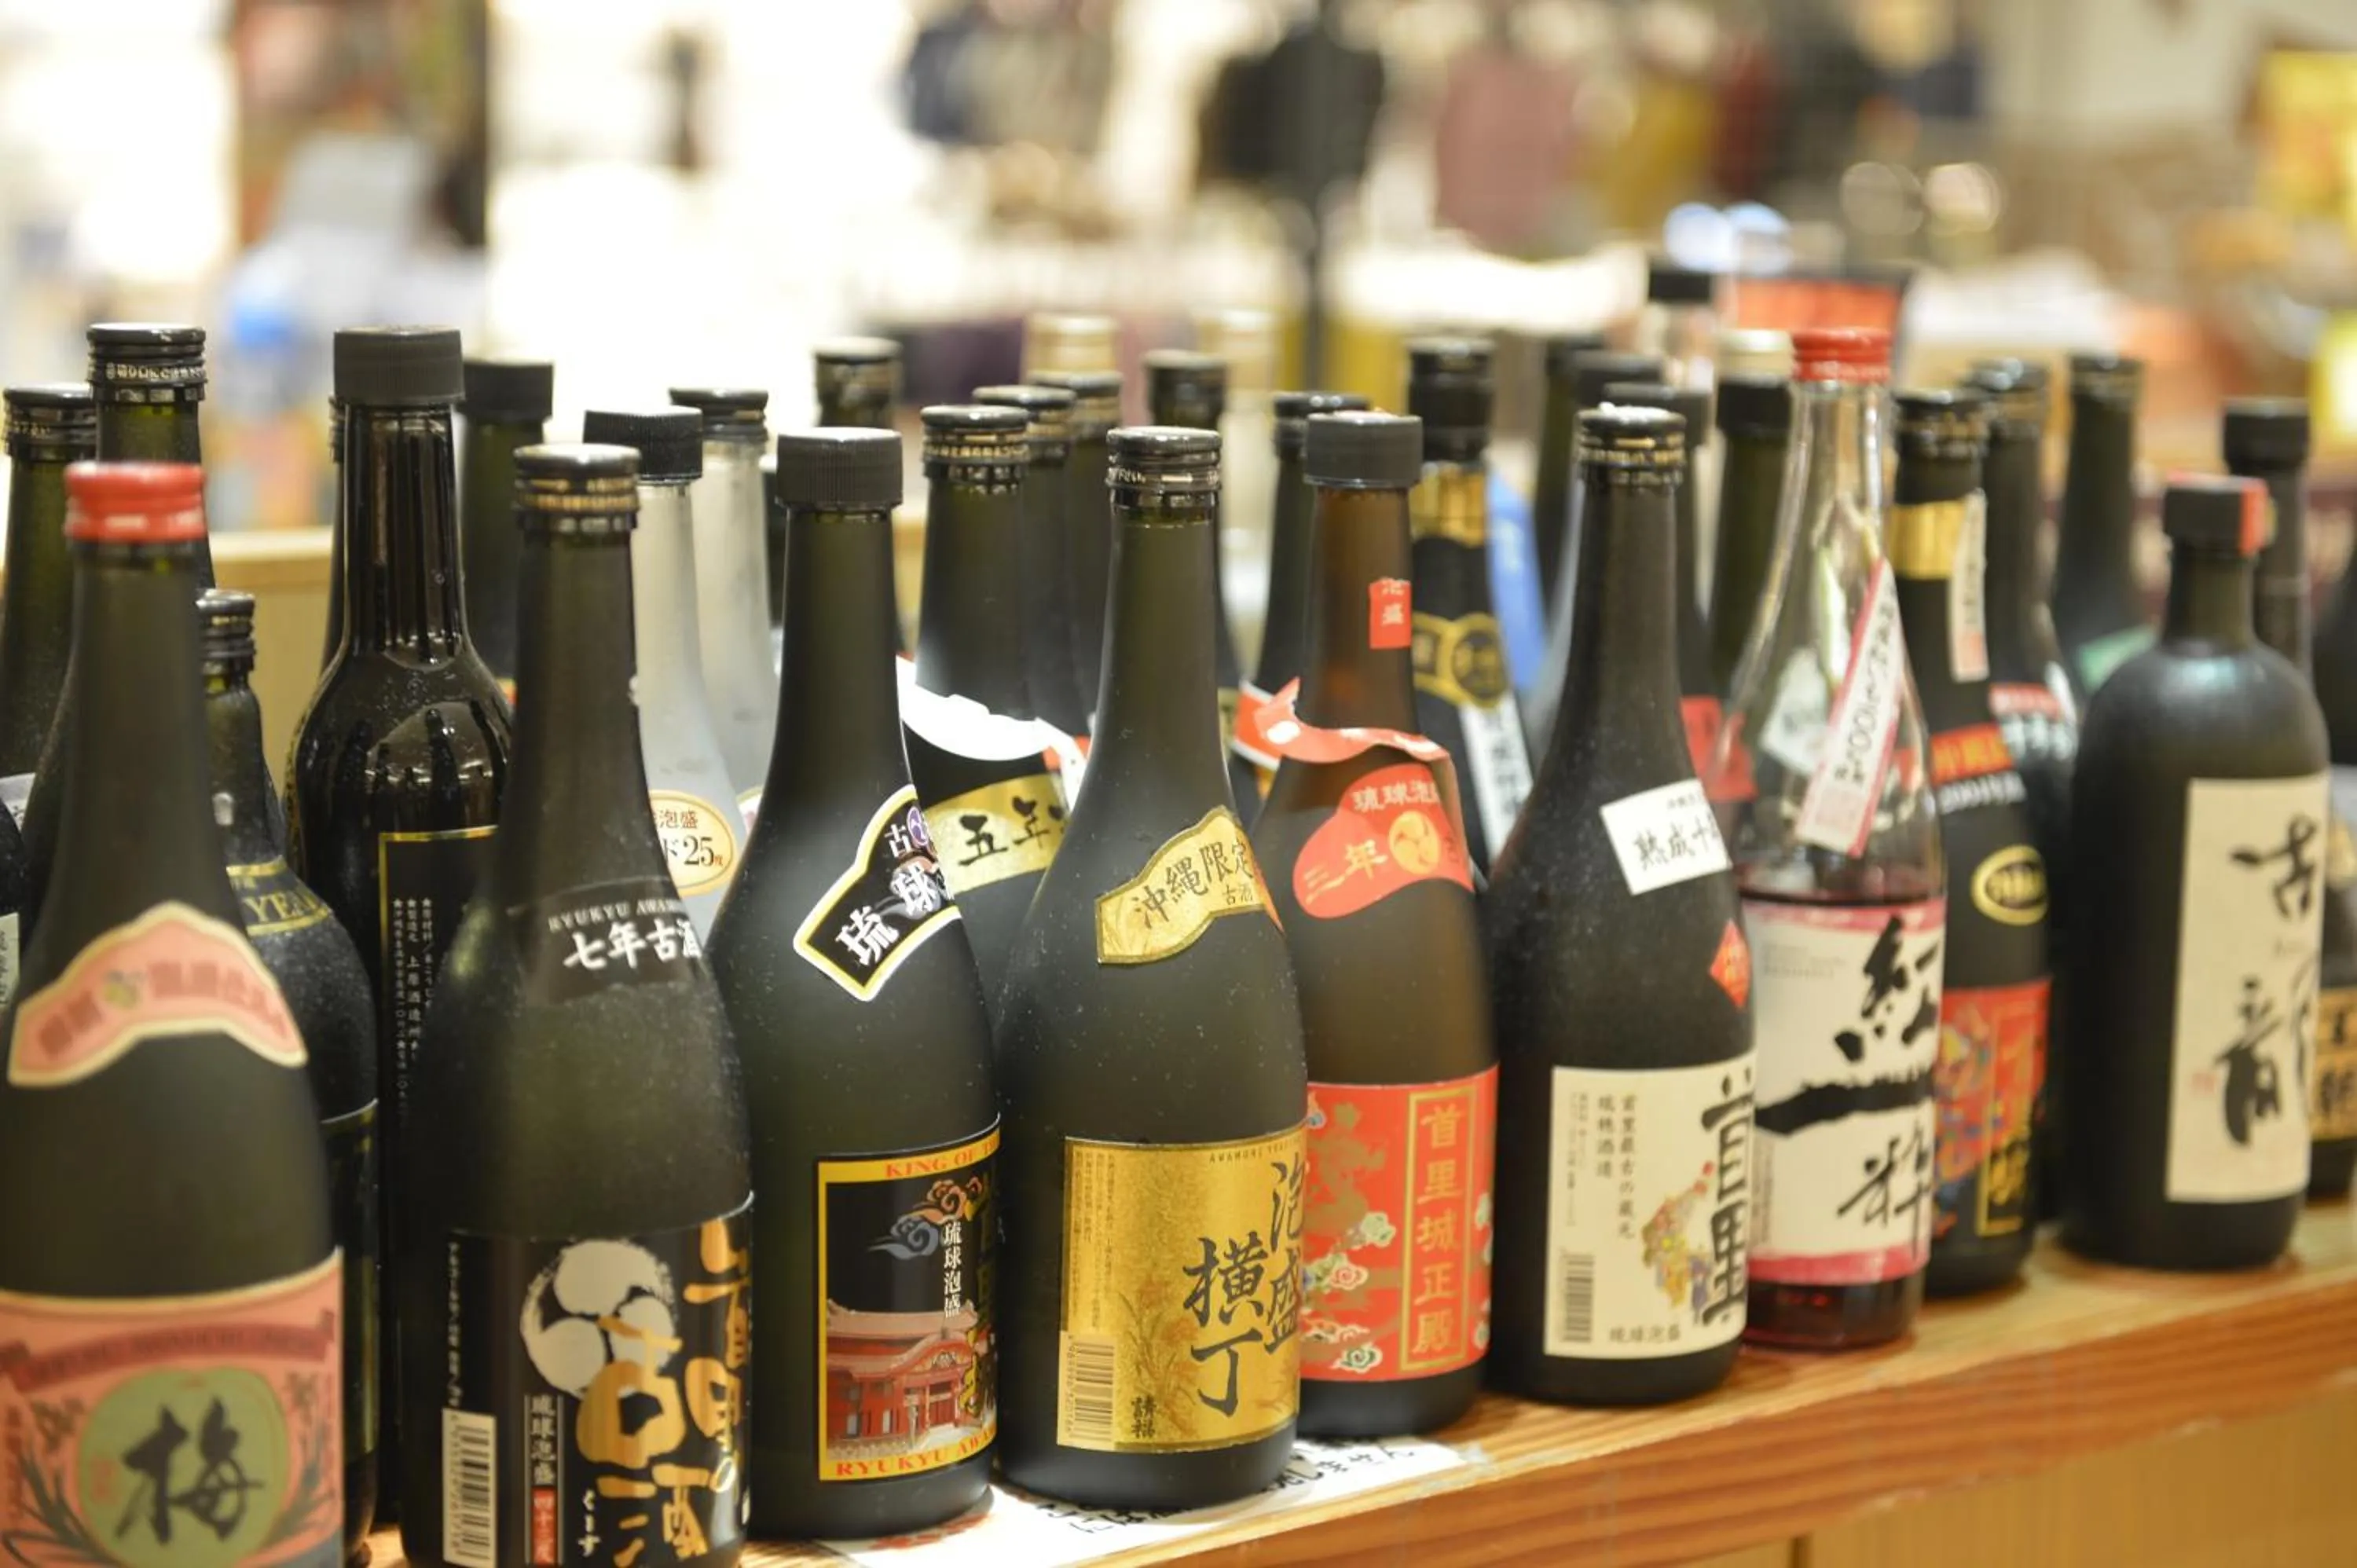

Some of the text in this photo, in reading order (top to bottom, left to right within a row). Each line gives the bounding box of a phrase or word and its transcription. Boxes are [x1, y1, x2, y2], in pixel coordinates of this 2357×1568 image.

[659, 808, 697, 830] 泡盛
[1131, 839, 1255, 929] 沖縄限定
[548, 901, 631, 934] RYUKYU
[563, 917, 702, 969] 七年古酒
[943, 1221, 962, 1318] 琉球泡盛
[1182, 1232, 1267, 1417] 横丁
[835, 1451, 947, 1477] RYUKYU
